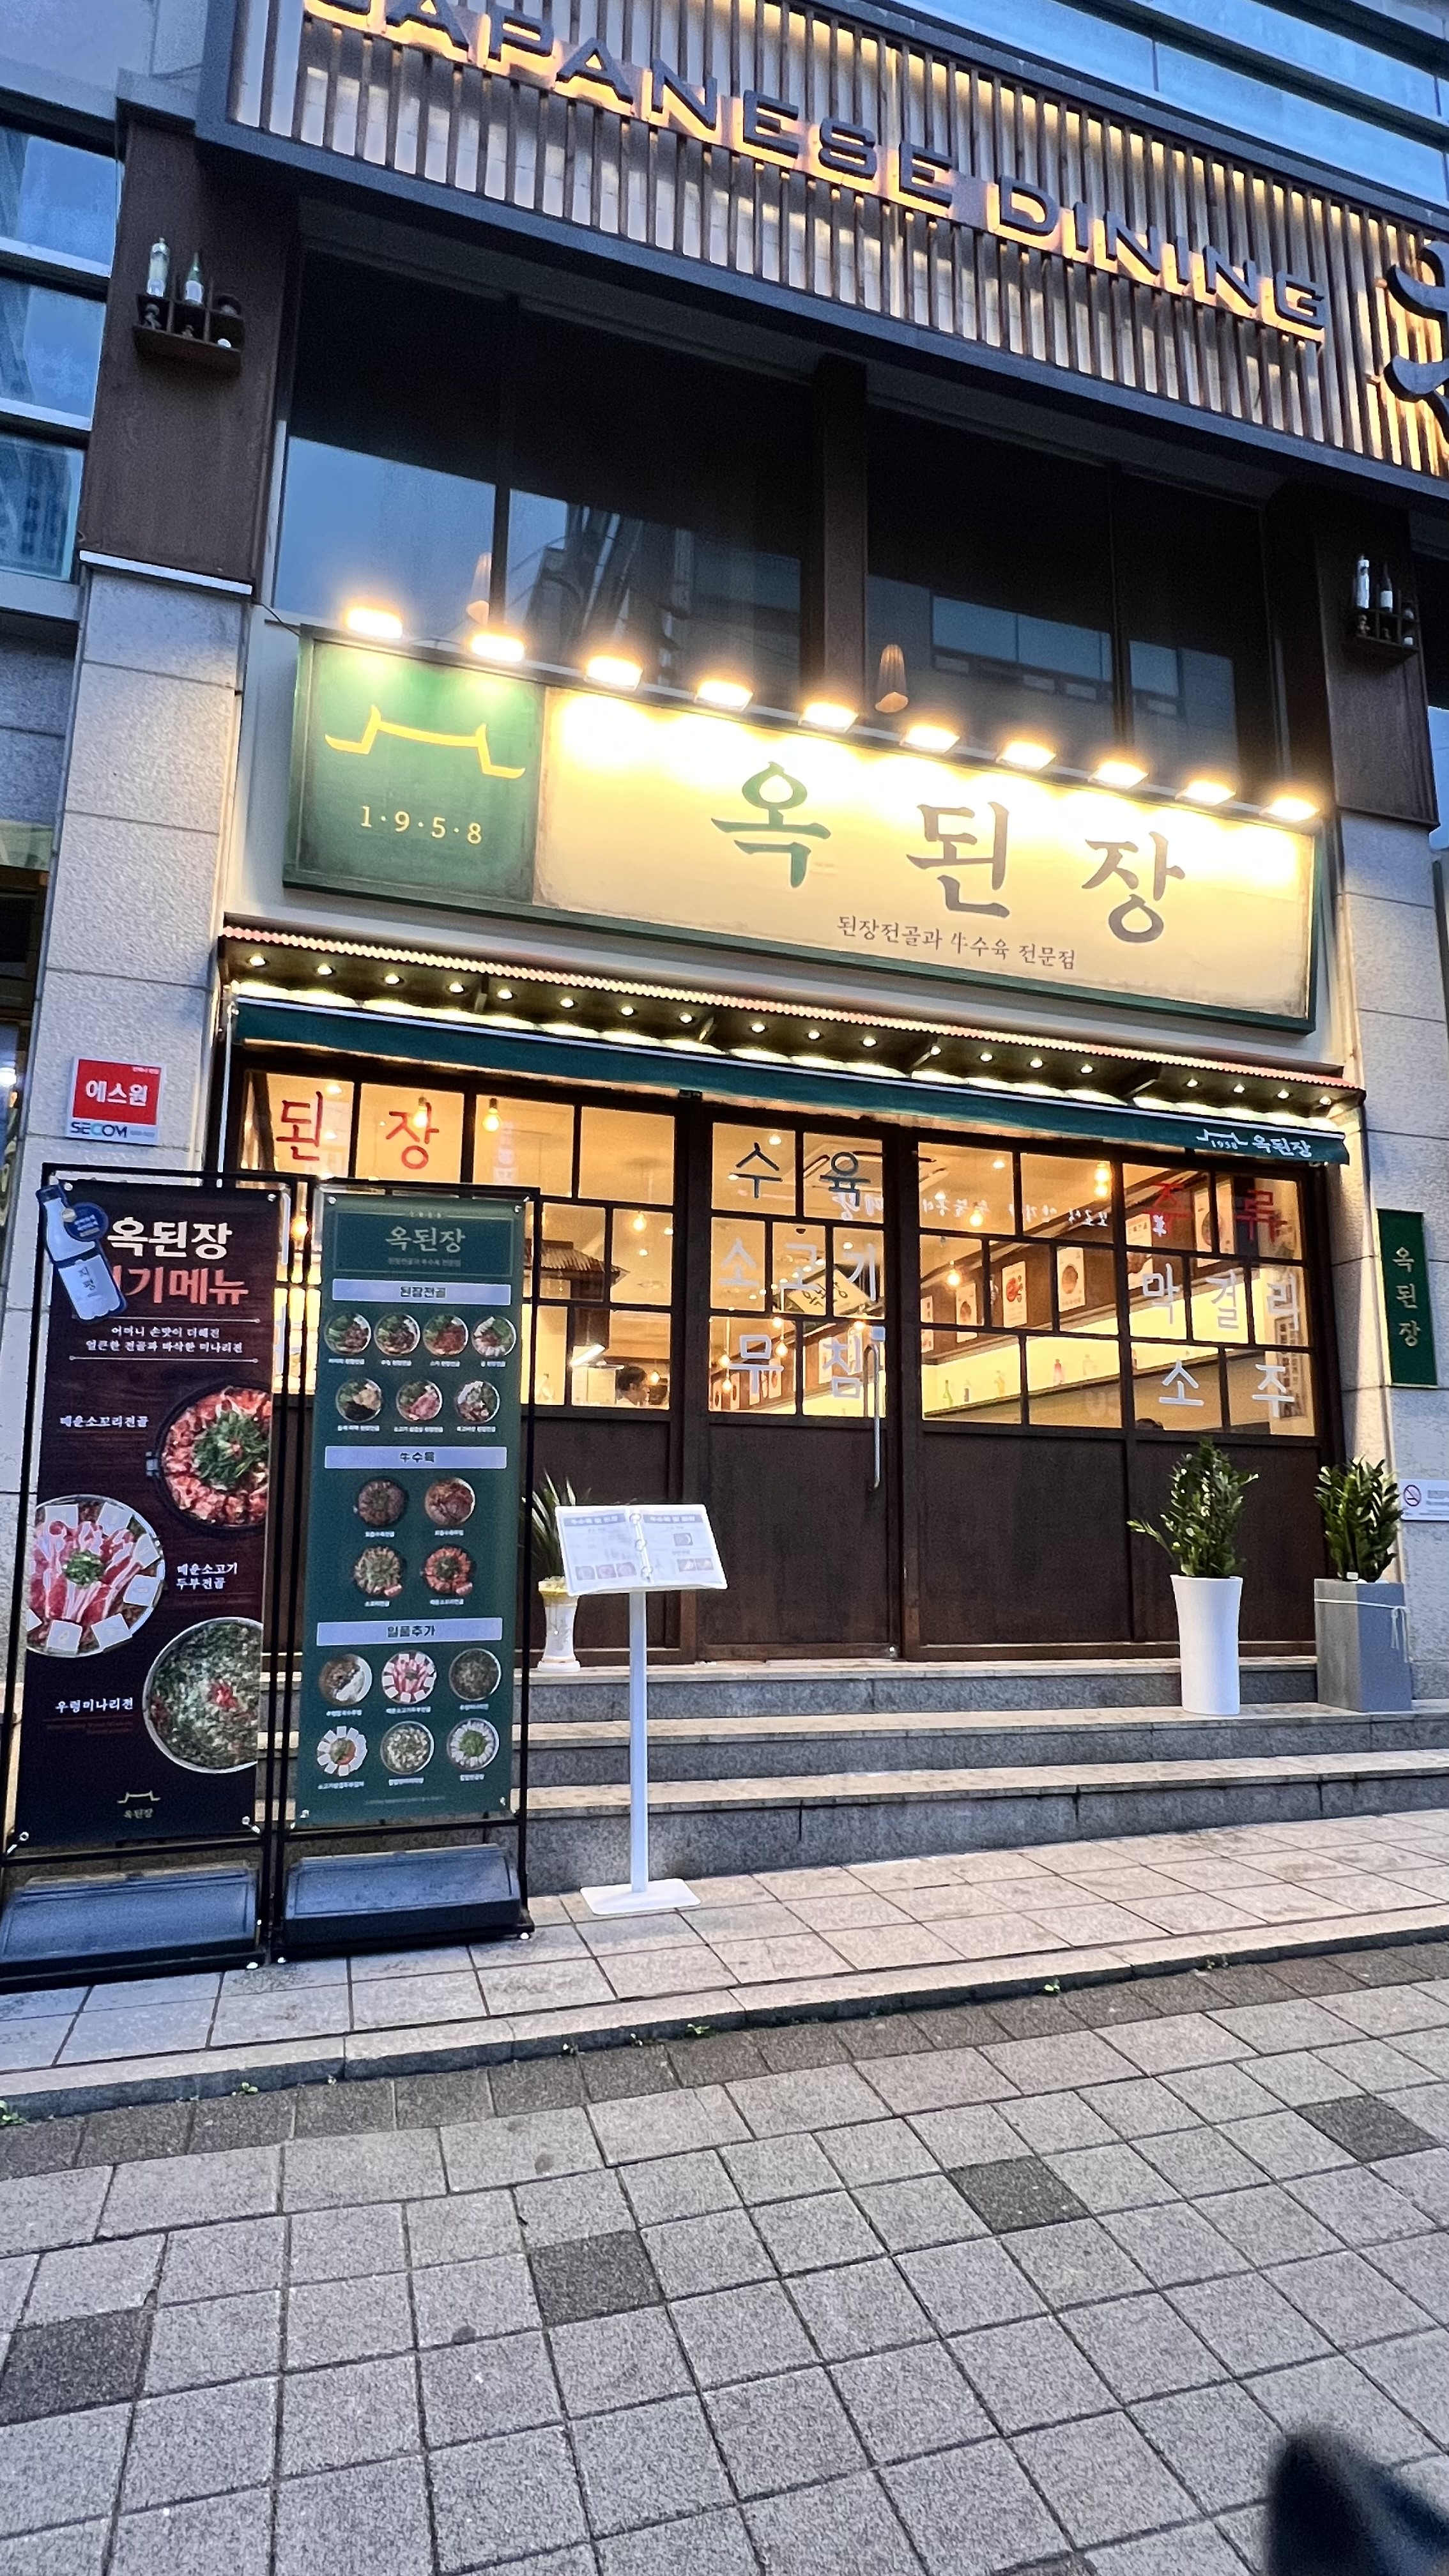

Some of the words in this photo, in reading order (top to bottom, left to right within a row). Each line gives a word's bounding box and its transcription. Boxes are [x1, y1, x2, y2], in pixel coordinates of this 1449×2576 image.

[999, 175, 1326, 330] DINING
[710, 760, 1186, 944] 옥된장
[837, 915, 943, 951] 된장전골과
[1018, 943, 1076, 970] 전문점
[86, 1080, 148, 1107] 에스원
[70, 1121, 128, 1138] SECOM
[276, 1091, 440, 1169] 된장
[1252, 1135, 1312, 1158] 옥된장
[728, 1142, 871, 1208] 수육
[107, 1216, 233, 1260] 옥된장
[385, 1226, 466, 1254] 옥된장
[718, 1237, 877, 1303] 소고기
[1142, 1262, 1300, 1331] 막걸리
[1391, 1246, 1422, 1347] 옥된장
[111, 1325, 145, 1337] 어머니
[725, 1334, 864, 1398] 무침
[1158, 1358, 1296, 1418] 소주
